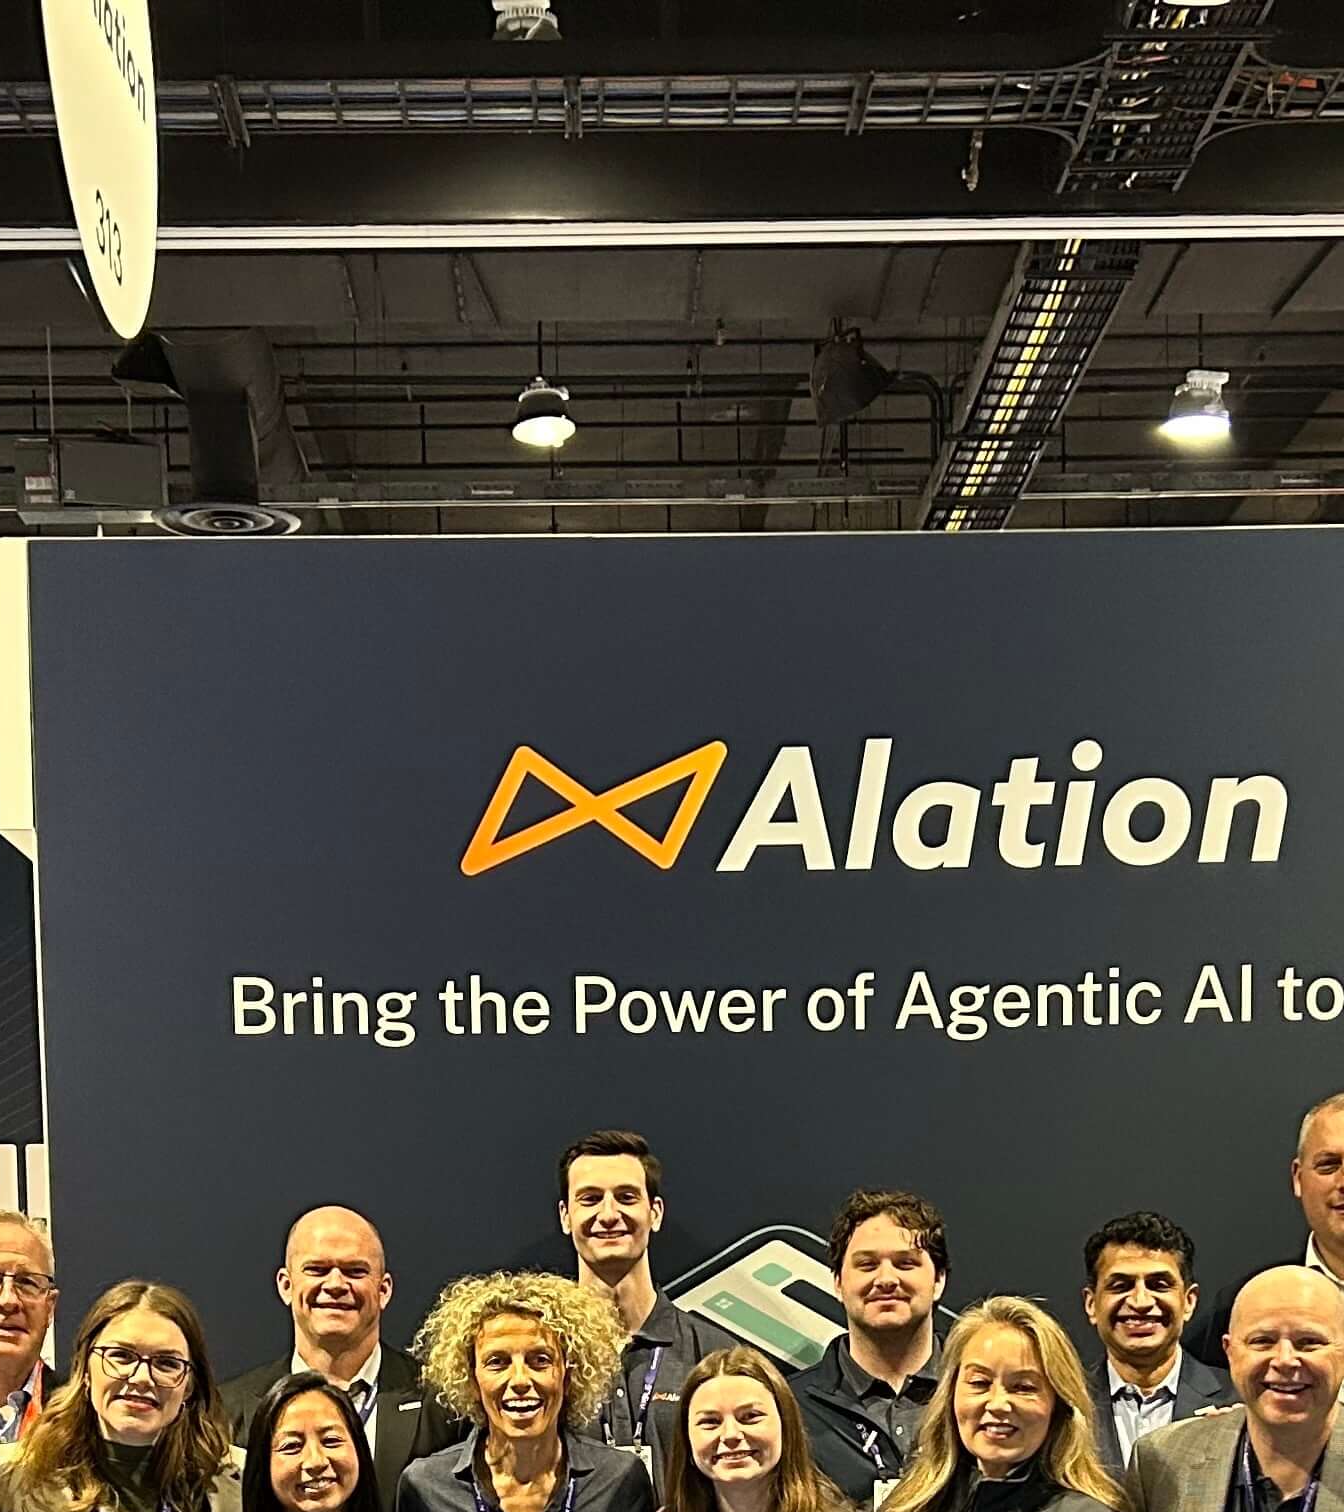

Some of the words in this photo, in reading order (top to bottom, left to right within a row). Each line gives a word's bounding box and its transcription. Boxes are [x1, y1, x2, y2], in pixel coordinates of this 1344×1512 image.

[95, 188, 123, 287] 313
[717, 738, 1289, 872] Alation
[232, 975, 417, 1047] Bring
[438, 975, 550, 1036] the
[573, 973, 788, 1036] Power
[804, 968, 875, 1032] of
[896, 965, 1163, 1042] Agentic
[1184, 963, 1252, 1024] AI
[1279, 966, 1344, 1022] to
